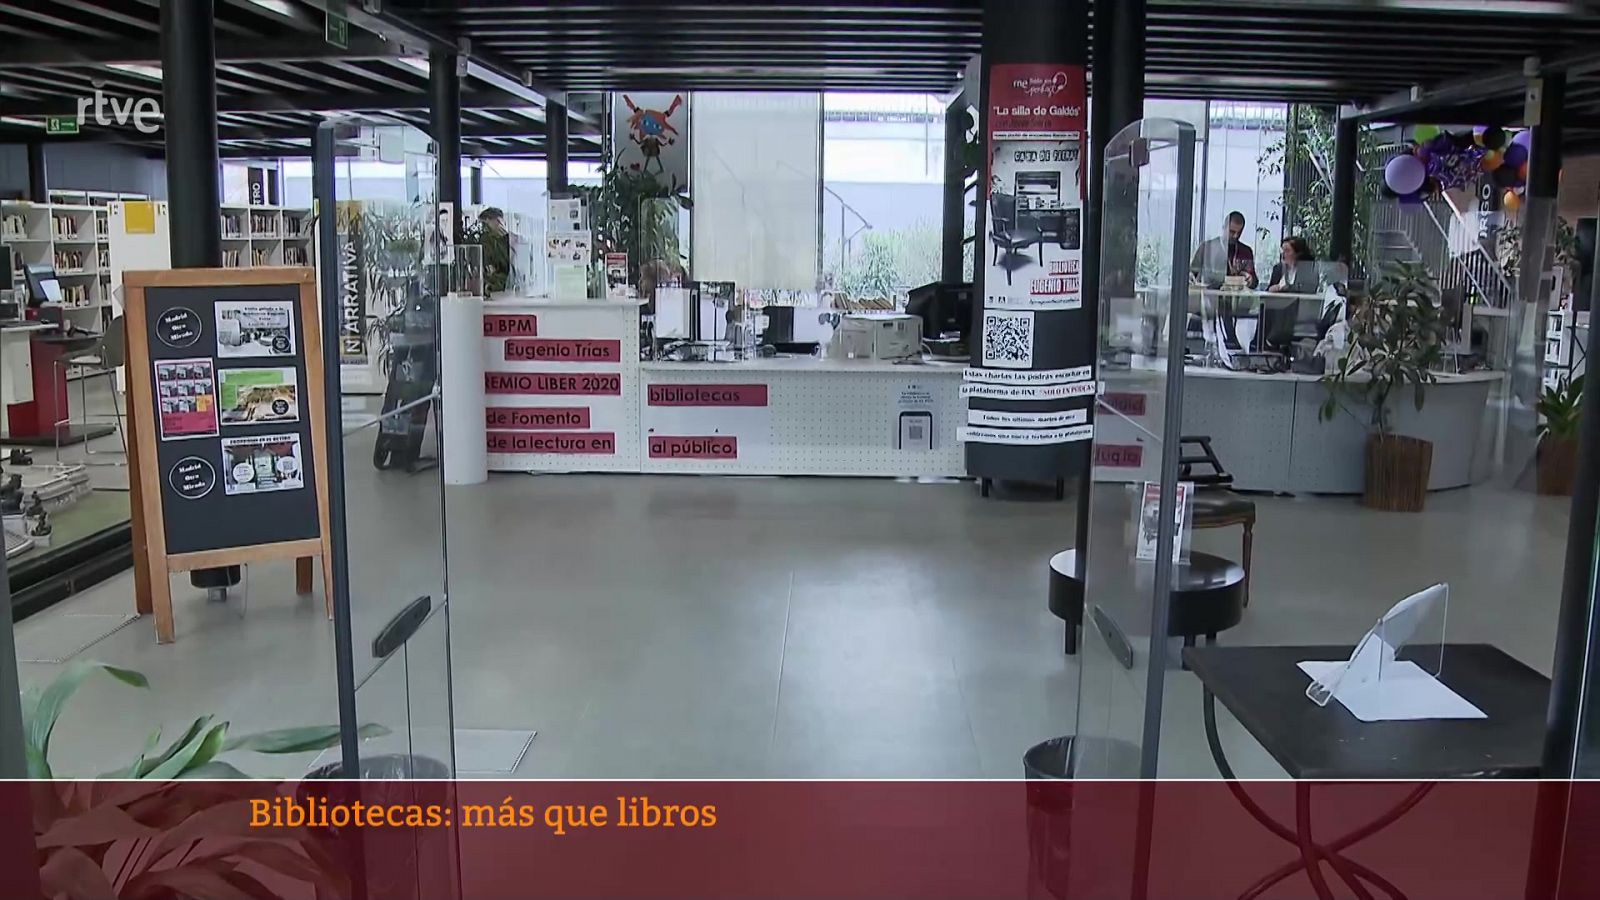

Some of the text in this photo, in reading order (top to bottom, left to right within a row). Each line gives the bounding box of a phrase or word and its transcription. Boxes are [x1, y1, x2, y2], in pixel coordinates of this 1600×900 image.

[1012, 105, 1031, 116] silla
[1033, 105, 1047, 116] de
[1039, 149, 1051, 162] DE
[1031, 279, 1061, 293] EUGENIO
[344, 241, 360, 353] NARRATIVA
[165, 313, 188, 323] Madrid
[499, 319, 532, 332] BPM
[507, 342, 610, 360] Eugenio Trías
[538, 377, 577, 390] LIBER
[582, 377, 619, 391] 2020
[650, 388, 741, 402] bibliotecas
[969, 386, 1008, 396] plataforma
[487, 411, 581, 425] de Fomento
[487, 436, 611, 449] de la lectura en
[652, 440, 666, 454] al
[179, 464, 201, 473] Madrid
